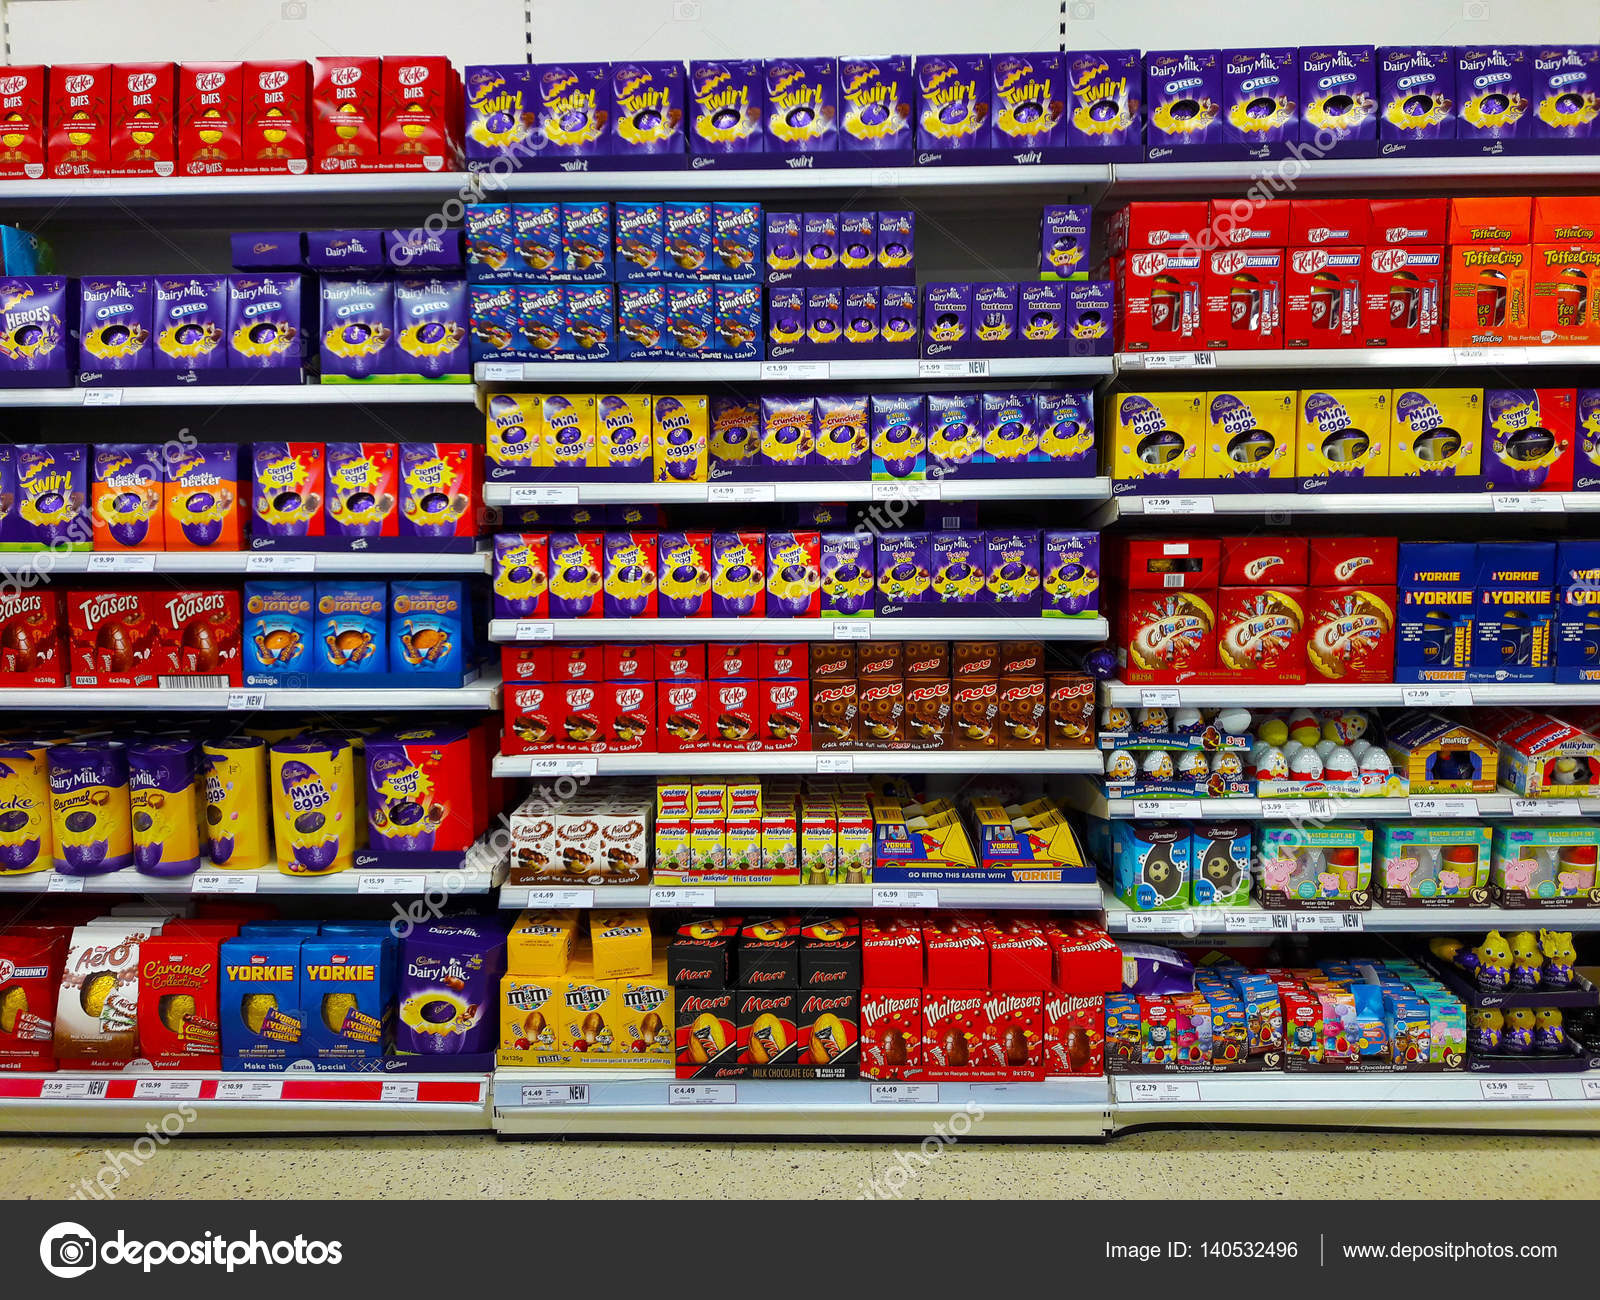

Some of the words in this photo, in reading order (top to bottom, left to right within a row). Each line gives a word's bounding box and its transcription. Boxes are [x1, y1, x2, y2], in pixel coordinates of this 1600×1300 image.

[1150, 63, 1177, 78] Dairy
[1304, 59, 1331, 72] Dairy
[844, 81, 897, 106] Twirl
[1072, 77, 1126, 102] Twirl
[470, 90, 524, 114] Twirl
[695, 85, 749, 110] Twirl
[84, 290, 110, 302] Dairy
[5, 306, 51, 329] HEROES
[1194, 353, 1212, 366] NEW
[969, 361, 985, 374] NEW
[496, 415, 523, 428] Mini
[1318, 407, 1347, 422] Mini
[1502, 407, 1530, 421] creme
[662, 415, 689, 430] Mini
[1319, 417, 1350, 432] eggs
[1506, 416, 1527, 428] egg
[501, 443, 529, 456] eggs
[667, 445, 695, 457] eggs
[340, 461, 369, 475] creme
[19, 471, 72, 495] Twirl
[345, 473, 367, 485] egg
[1419, 572, 1460, 581] YORKIE
[1413, 592, 1473, 605] YORKIE
[79, 594, 138, 631] Teasers
[165, 593, 225, 630] Teasers
[246, 696, 262, 706] NEW
[50, 776, 72, 791] Dairy
[388, 771, 419, 786] creme
[291, 779, 323, 799] Mini
[393, 782, 417, 795] egg
[294, 793, 329, 811] eggs
[733, 875, 747, 883] this
[749, 875, 773, 883] Easter
[1012, 870, 1062, 882] YORKIE
[1272, 914, 1288, 928] NEW
[1343, 914, 1359, 928] NEW
[14, 966, 48, 978] CHUNKY
[143, 961, 211, 980] Caramel
[227, 965, 294, 981] YORKIE
[307, 965, 375, 981] YORKIE
[408, 965, 440, 981] Dairy
[441, 964, 469, 979] Milk
[680, 996, 731, 1013] Mars
[802, 996, 853, 1013] Mars
[861, 997, 919, 1027] Maltesers
[1045, 995, 1103, 1024] Maltesers
[316, 1063, 346, 1072] Special
[87, 1082, 105, 1096] NEW
[569, 1085, 585, 1100] NEW
